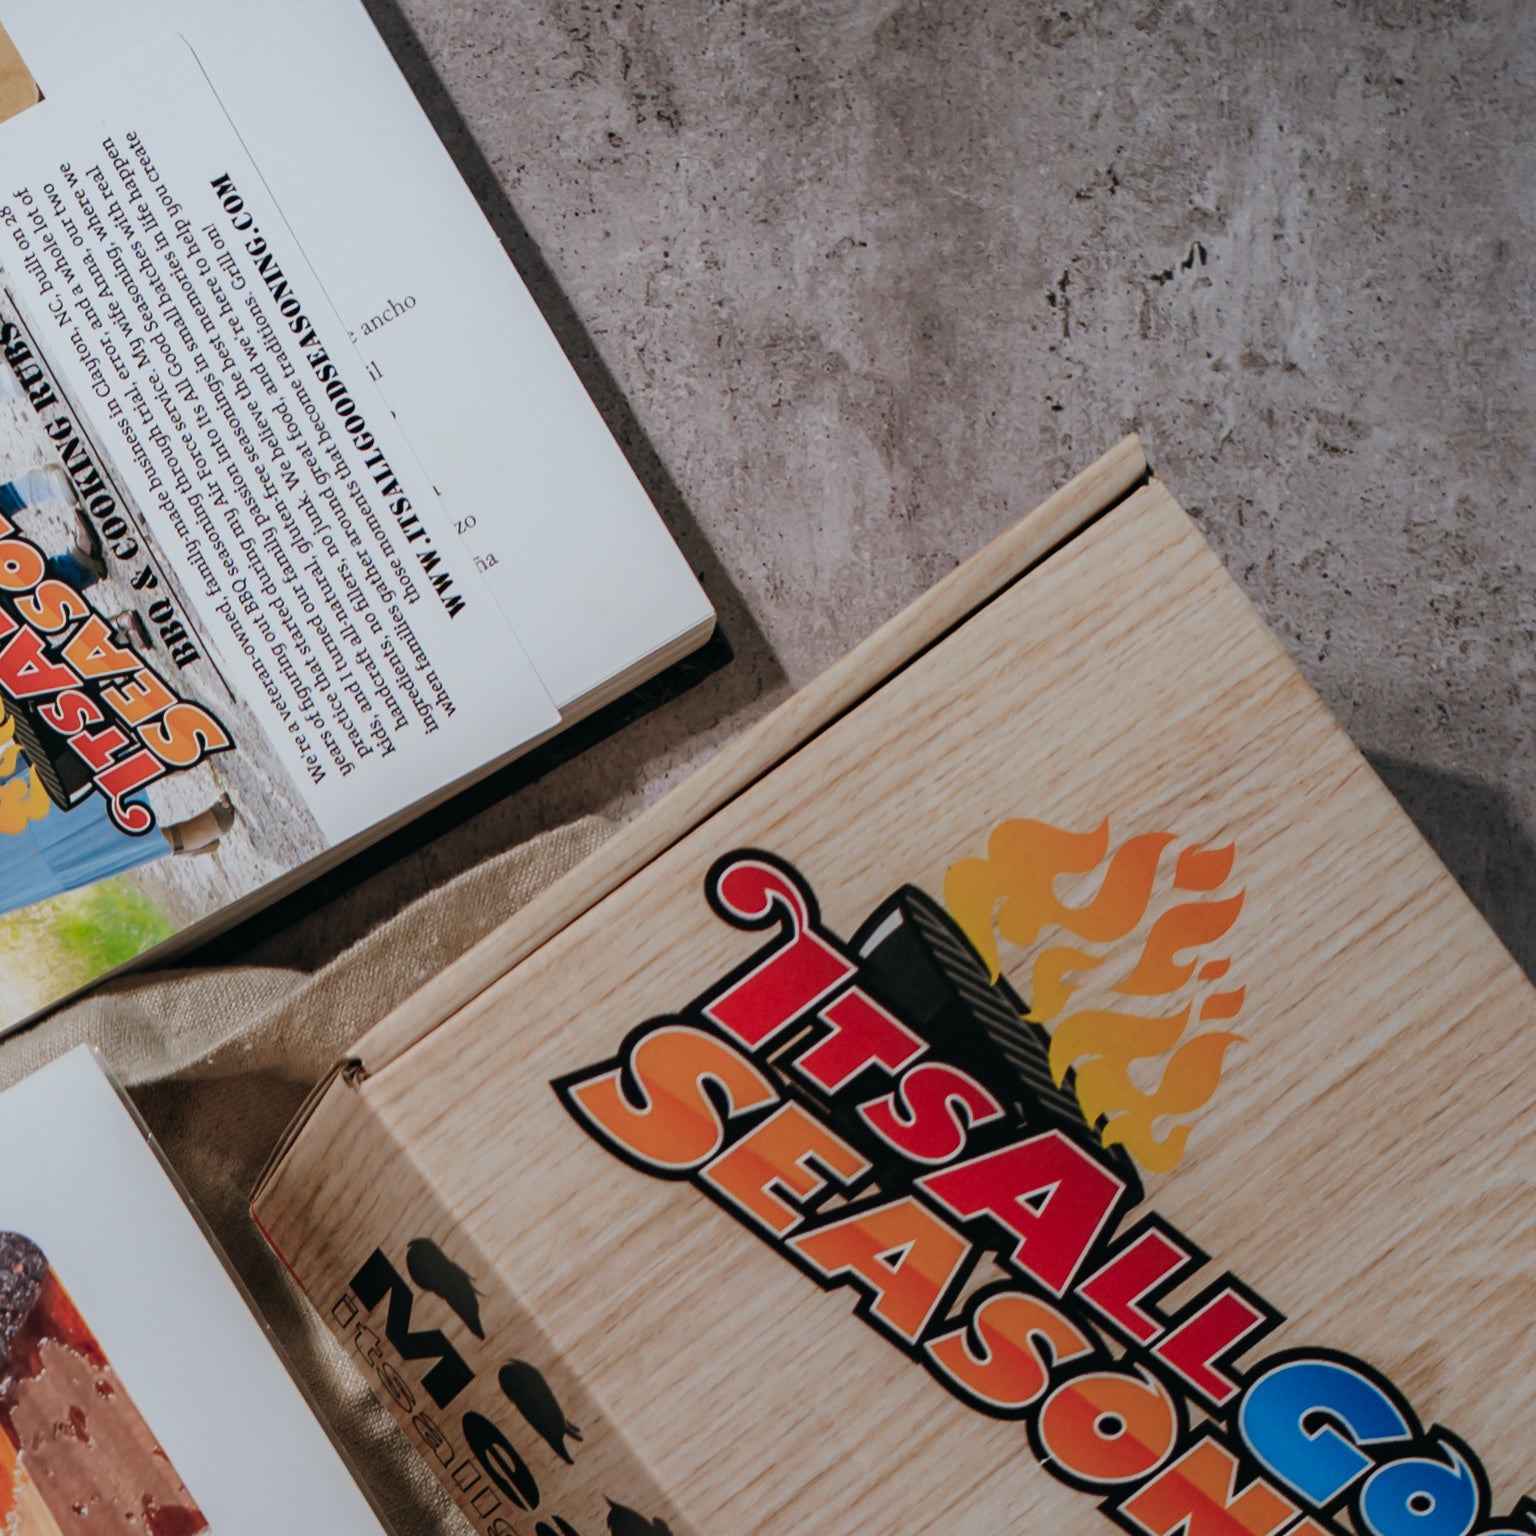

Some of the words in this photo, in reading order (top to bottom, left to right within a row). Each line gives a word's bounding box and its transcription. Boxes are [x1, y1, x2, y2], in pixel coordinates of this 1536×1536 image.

[12, 227, 30, 250] on
[201, 223, 225, 249] on!
[23, 252, 53, 295] built
[215, 250, 246, 290] Grill
[47, 293, 72, 327] NC,
[360, 295, 416, 336] ancho
[244, 291, 295, 378] traditions.
[69, 326, 110, 397] Clayton,
[106, 397, 123, 419] in
[210, 173, 465, 618] WWW.ITSALLGOODSEASONING.COM
[290, 379, 332, 445] become
[117, 417, 163, 492] business
[324, 443, 351, 480] that
[44, 416, 139, 560] COOKING
[157, 490, 221, 596] family-made
[346, 480, 395, 558] moments
[129, 564, 158, 590] &
[389, 558, 420, 604] those
[148, 596, 201, 670] BBQ
[214, 595, 291, 721] veteran-owned,
[287, 720, 300, 733] a
[294, 734, 326, 785] We're
